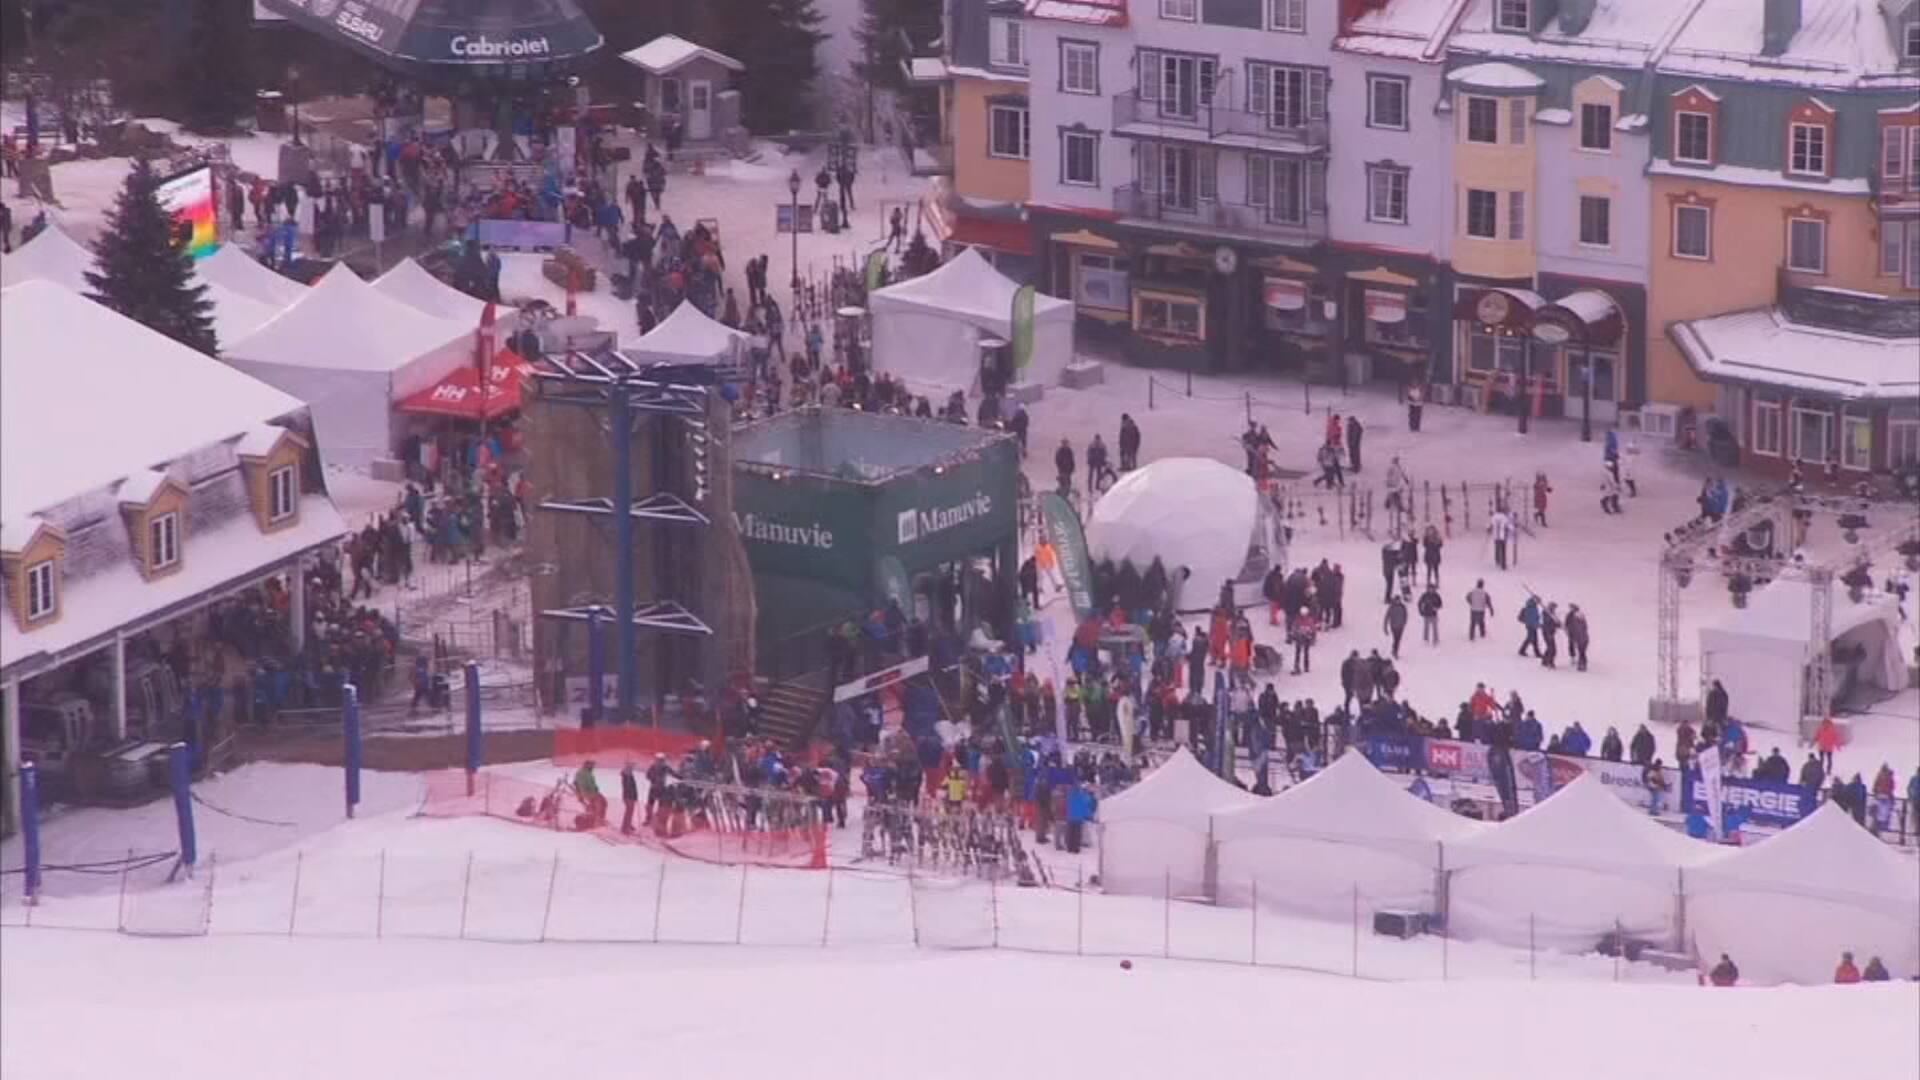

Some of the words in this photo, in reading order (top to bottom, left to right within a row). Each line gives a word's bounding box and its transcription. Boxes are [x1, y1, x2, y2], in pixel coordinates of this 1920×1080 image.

[451, 35, 549, 56] Cabriolet
[730, 511, 833, 549] Manuvie
[919, 491, 993, 535] Manuvie
